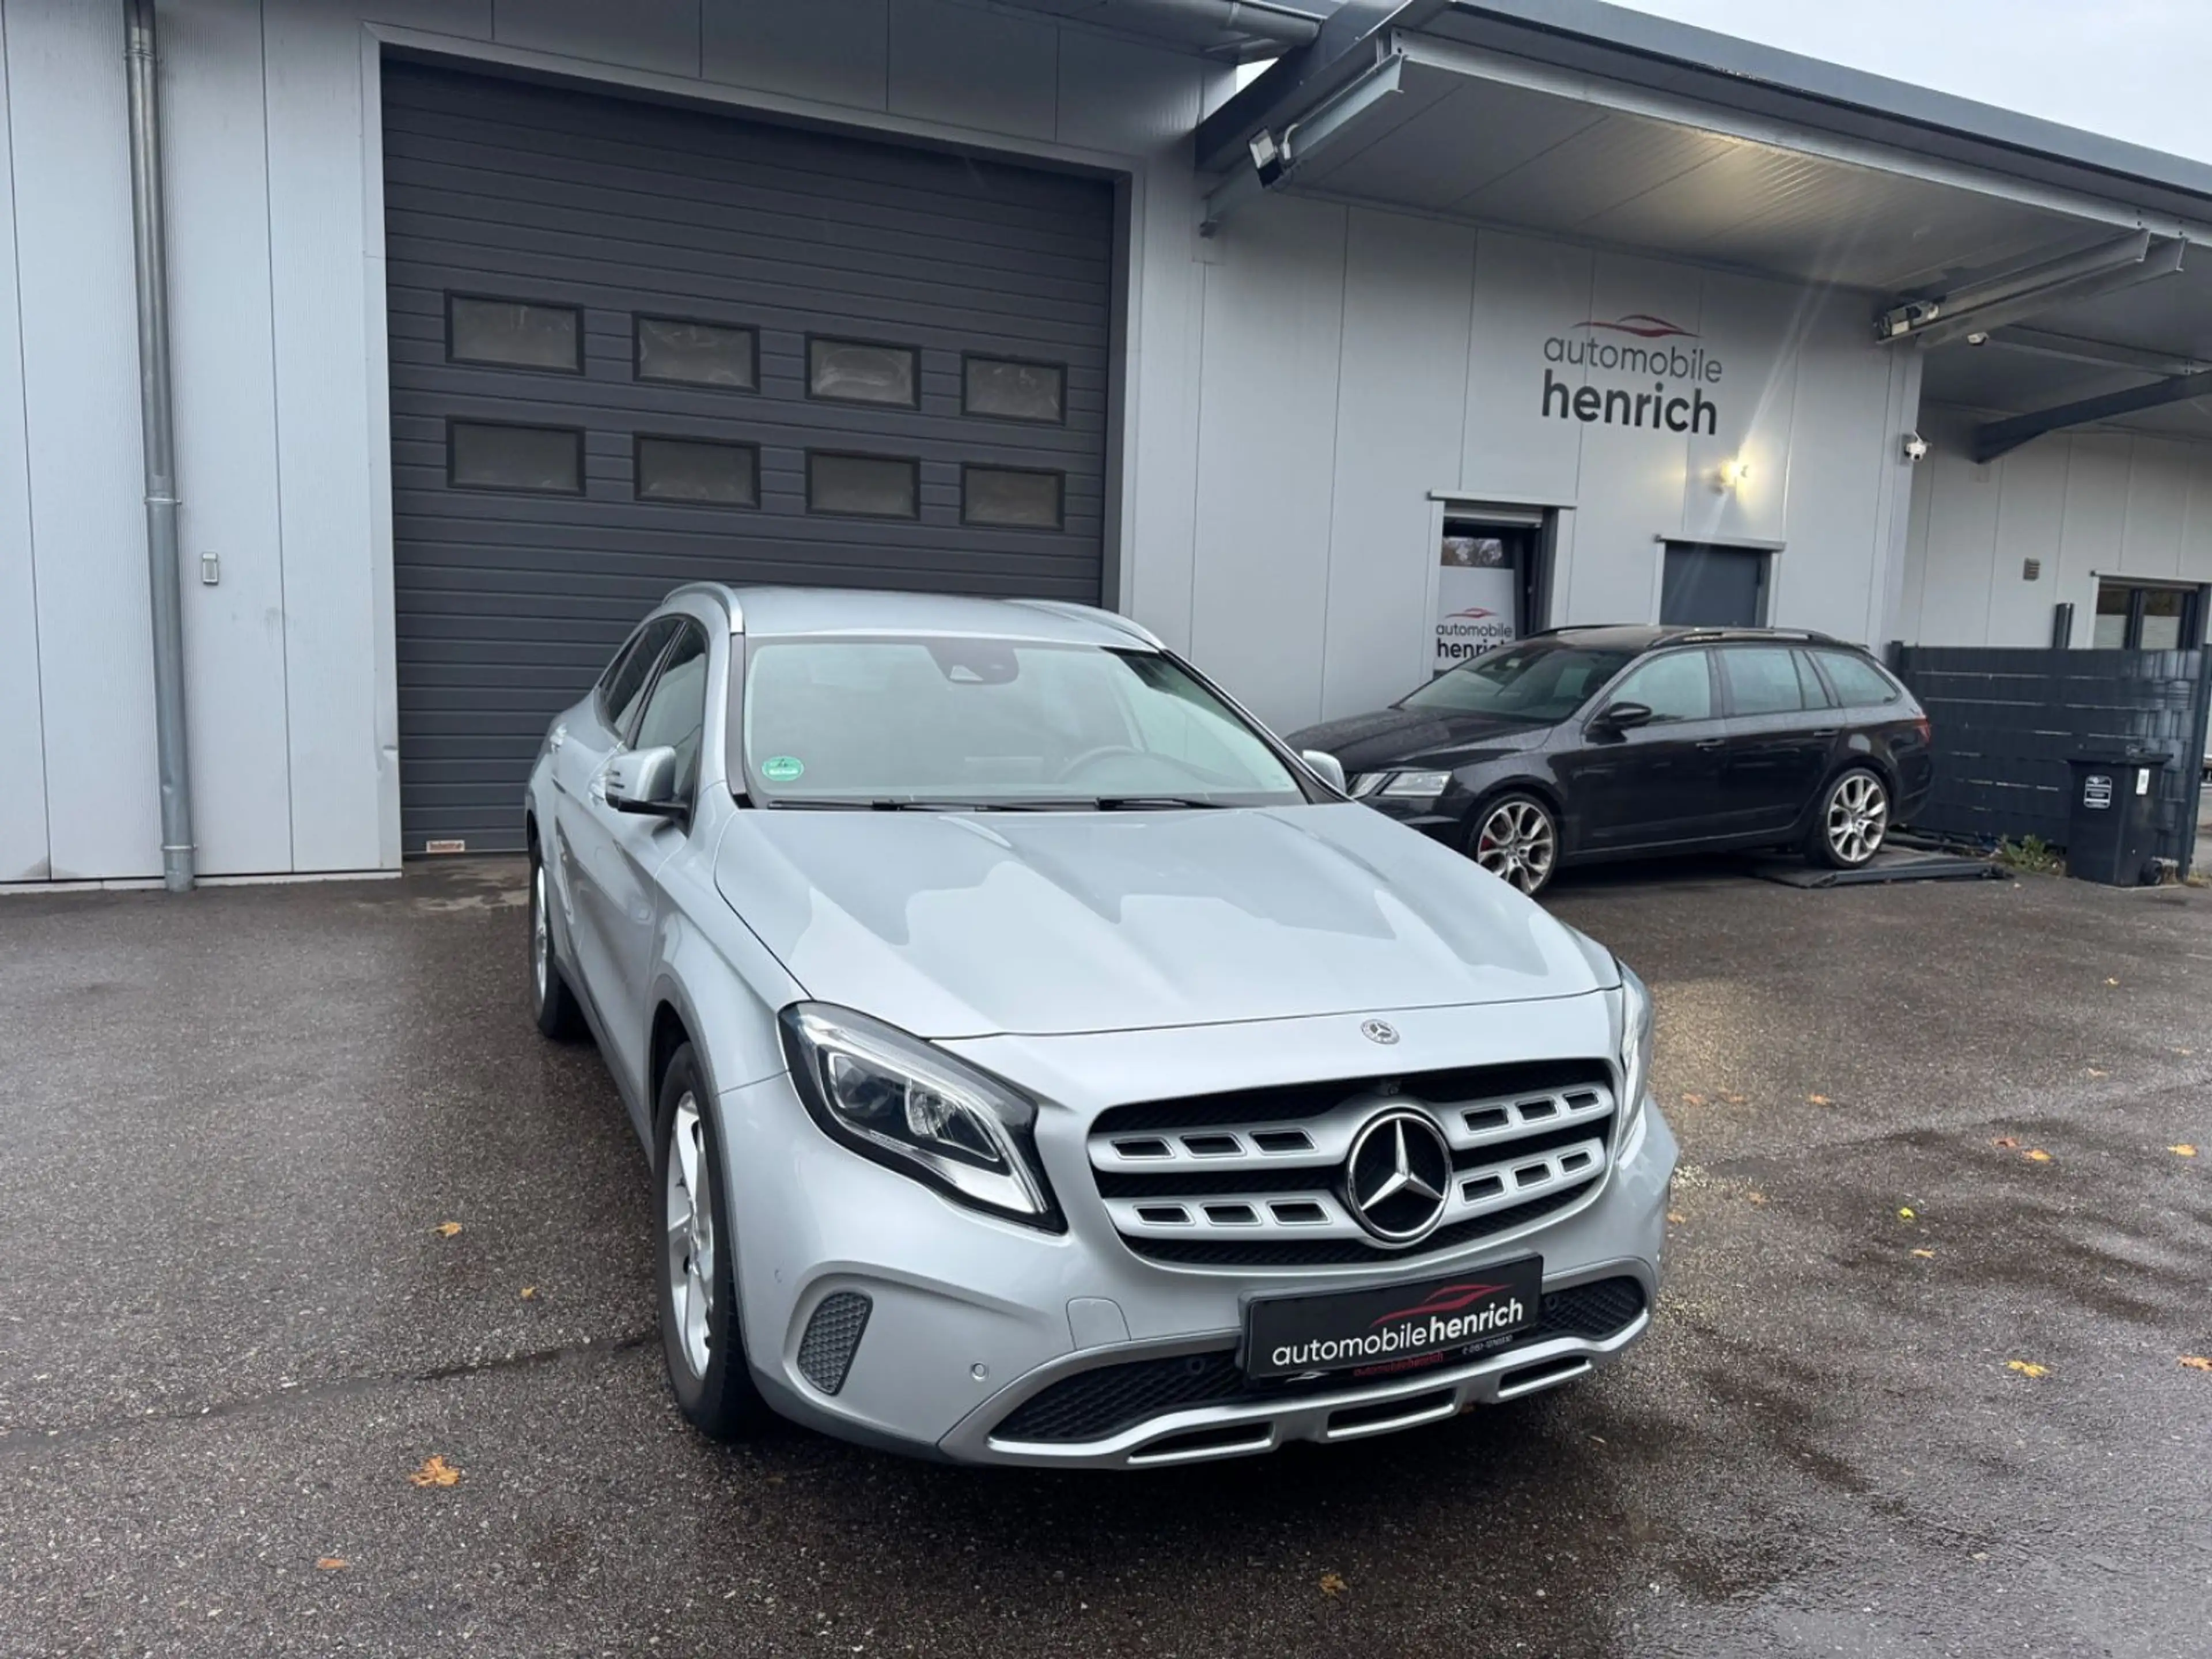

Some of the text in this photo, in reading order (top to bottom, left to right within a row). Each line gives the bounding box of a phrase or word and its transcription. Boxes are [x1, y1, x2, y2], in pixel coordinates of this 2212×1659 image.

[1544, 337, 1722, 383] automobile
[1541, 369, 1717, 435] henrich
[1436, 623, 1513, 638] automobile
[1437, 637, 1504, 658] henri
[1272, 1297, 1523, 1366] automobilehenrich
